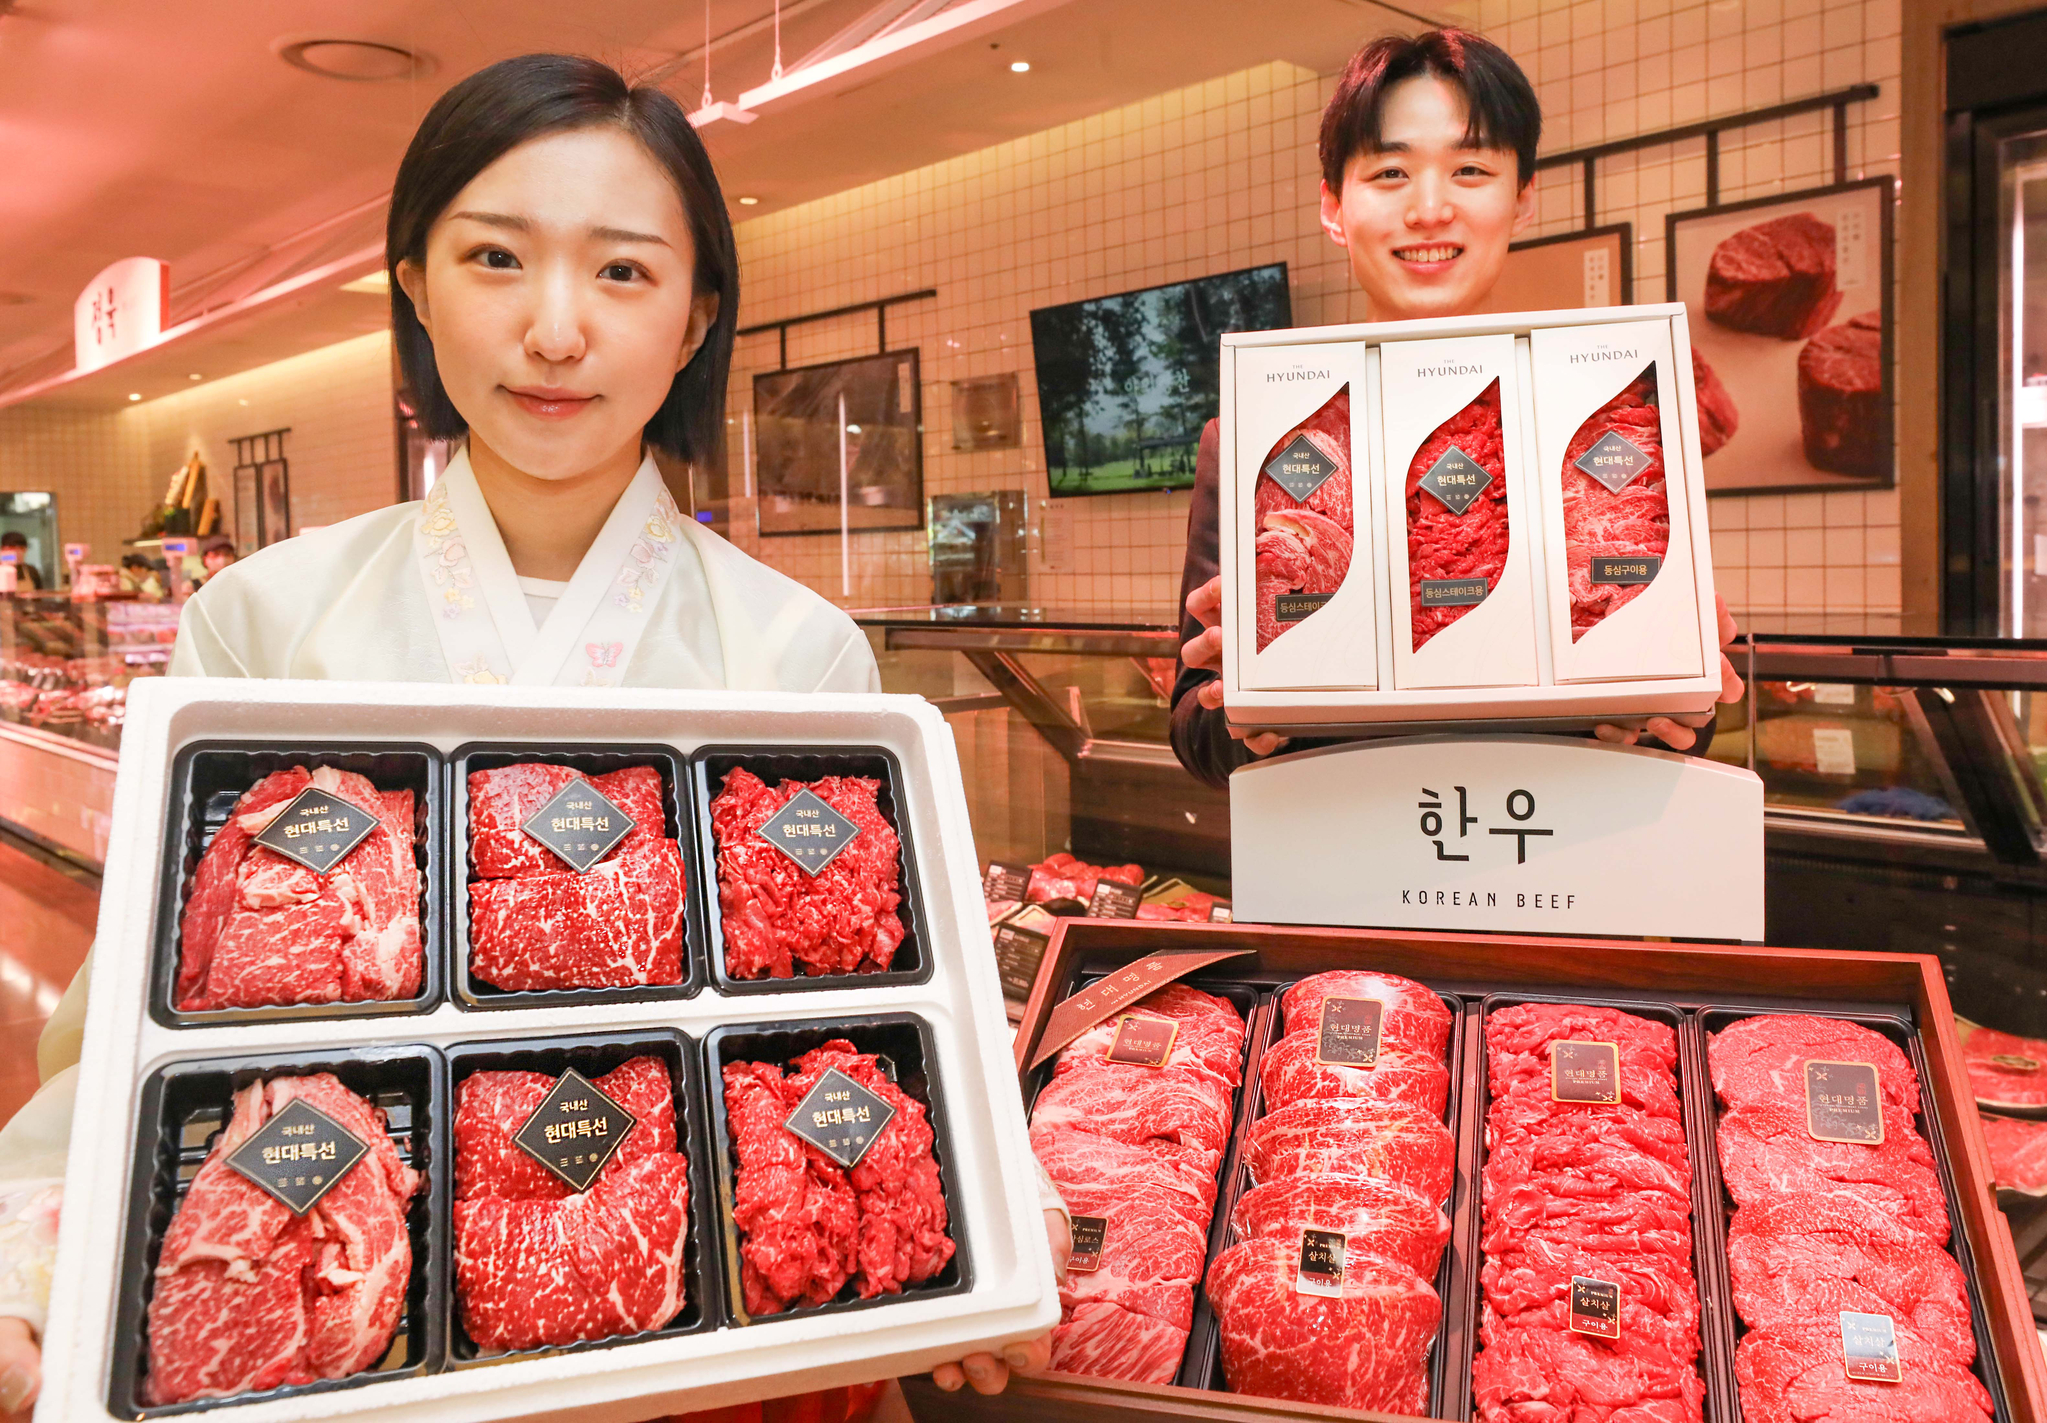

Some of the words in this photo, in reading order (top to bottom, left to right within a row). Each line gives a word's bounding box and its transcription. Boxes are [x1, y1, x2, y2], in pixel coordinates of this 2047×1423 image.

[1570, 349, 1638, 364] HYUNDAI
[1266, 369, 1330, 383] HYUNDAI
[1417, 364, 1483, 378] HYUNDAI
[1293, 452, 1310, 460] 국내산
[1593, 455, 1634, 467] 현대특선
[1282, 463, 1320, 475] 현대특선
[1437, 474, 1476, 487] 현대특선
[1604, 565, 1648, 576] 등심구이용
[1425, 585, 1483, 599] 등심스테이크용
[299, 805, 329, 817] 국내산
[566, 801, 592, 810] 국내산
[795, 809, 820, 818] 국내산
[284, 817, 350, 838] 현대특선
[551, 817, 610, 832] 현대특선
[782, 824, 837, 838] 현대특선
[1418, 786, 1554, 865] 한우
[1402, 889, 1497, 907] KOREAN
[1517, 893, 1575, 910] BEEF
[824, 1090, 851, 1102] 국내산
[1819, 1094, 1868, 1106] 현대명품
[559, 1099, 589, 1113] 국내산
[812, 1105, 871, 1128] 현대특선
[281, 1124, 315, 1137] 국내산
[544, 1117, 608, 1144] 현대특선
[262, 1141, 336, 1165] 현대특선
[1580, 1297, 1610, 1310] 살치살
[1582, 1319, 1608, 1330] 구이용
[1859, 1362, 1887, 1373] 구이용
